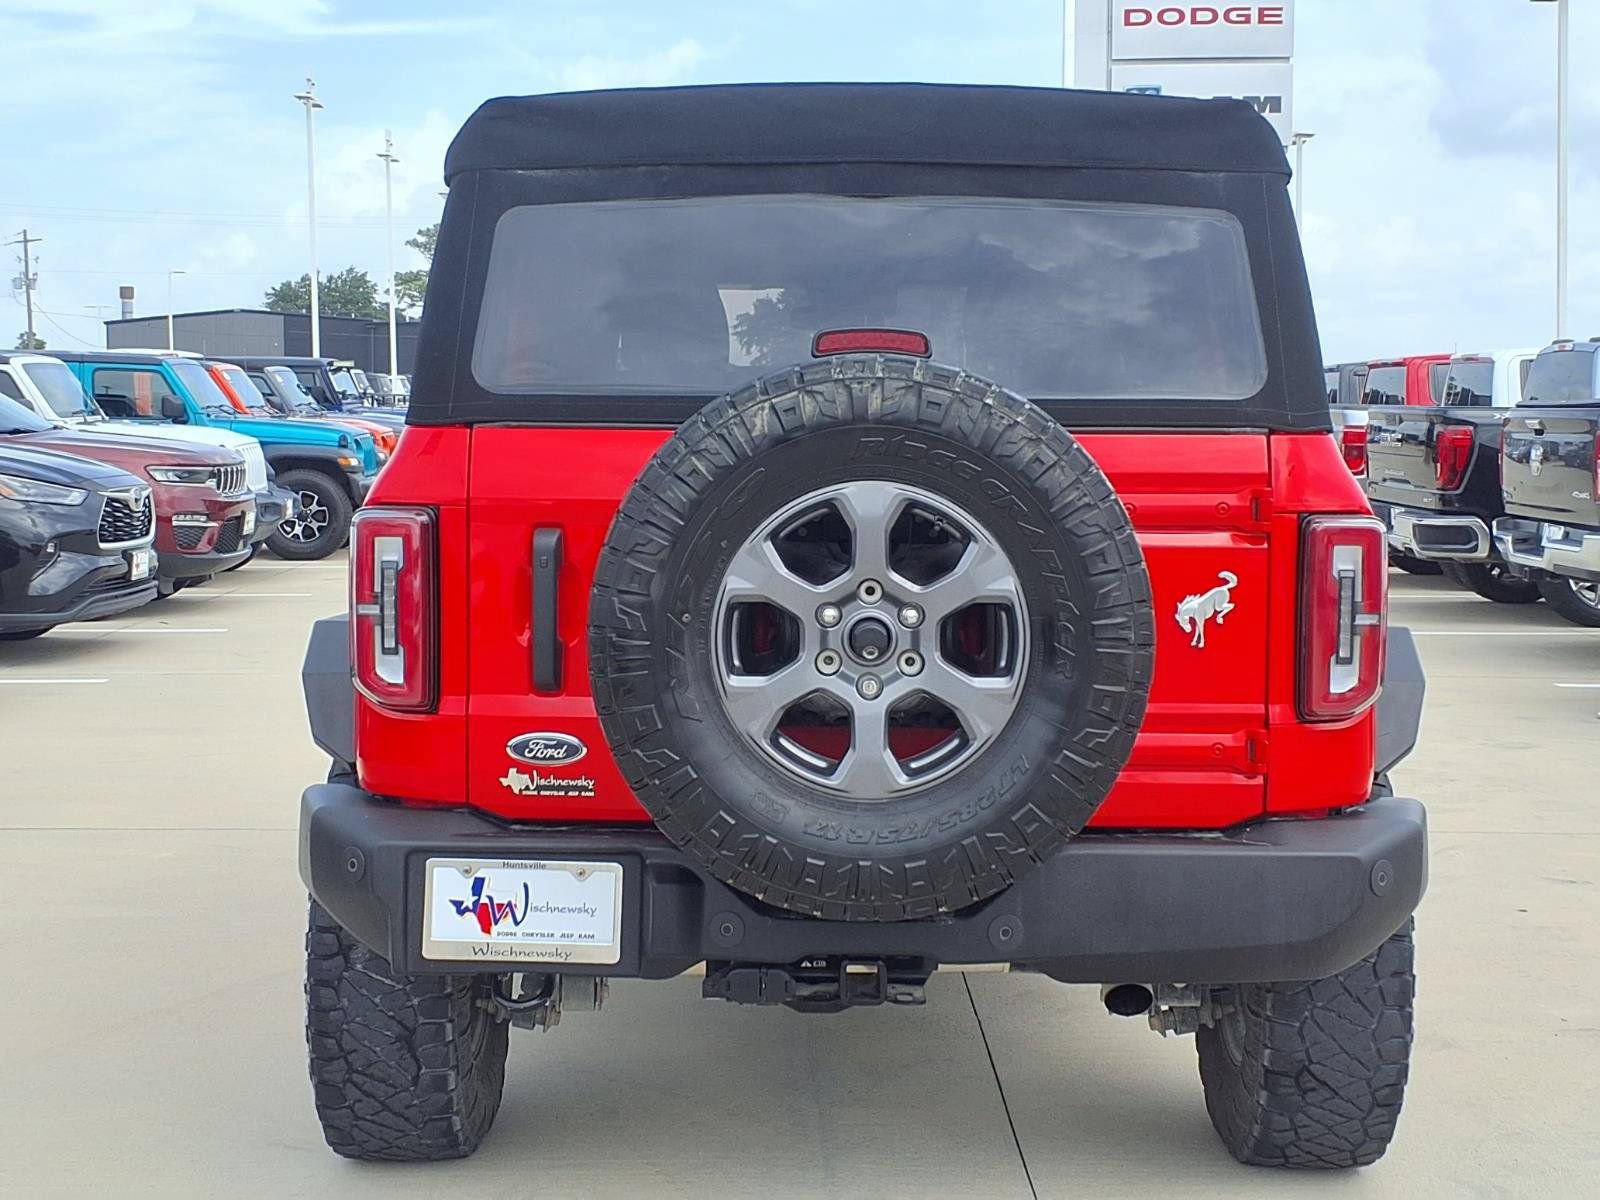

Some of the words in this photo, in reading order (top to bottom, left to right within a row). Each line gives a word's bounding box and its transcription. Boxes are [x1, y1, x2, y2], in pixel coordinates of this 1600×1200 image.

[1123, 7, 1284, 27] DODGE
[524, 739, 567, 759] Ford
[520, 769, 595, 790] Wischnewsky
[502, 861, 547, 870] Huntsville
[485, 881, 598, 927] Wischnewsky
[578, 932, 595, 940] RAM
[471, 942, 573, 961] Wischnewsky
